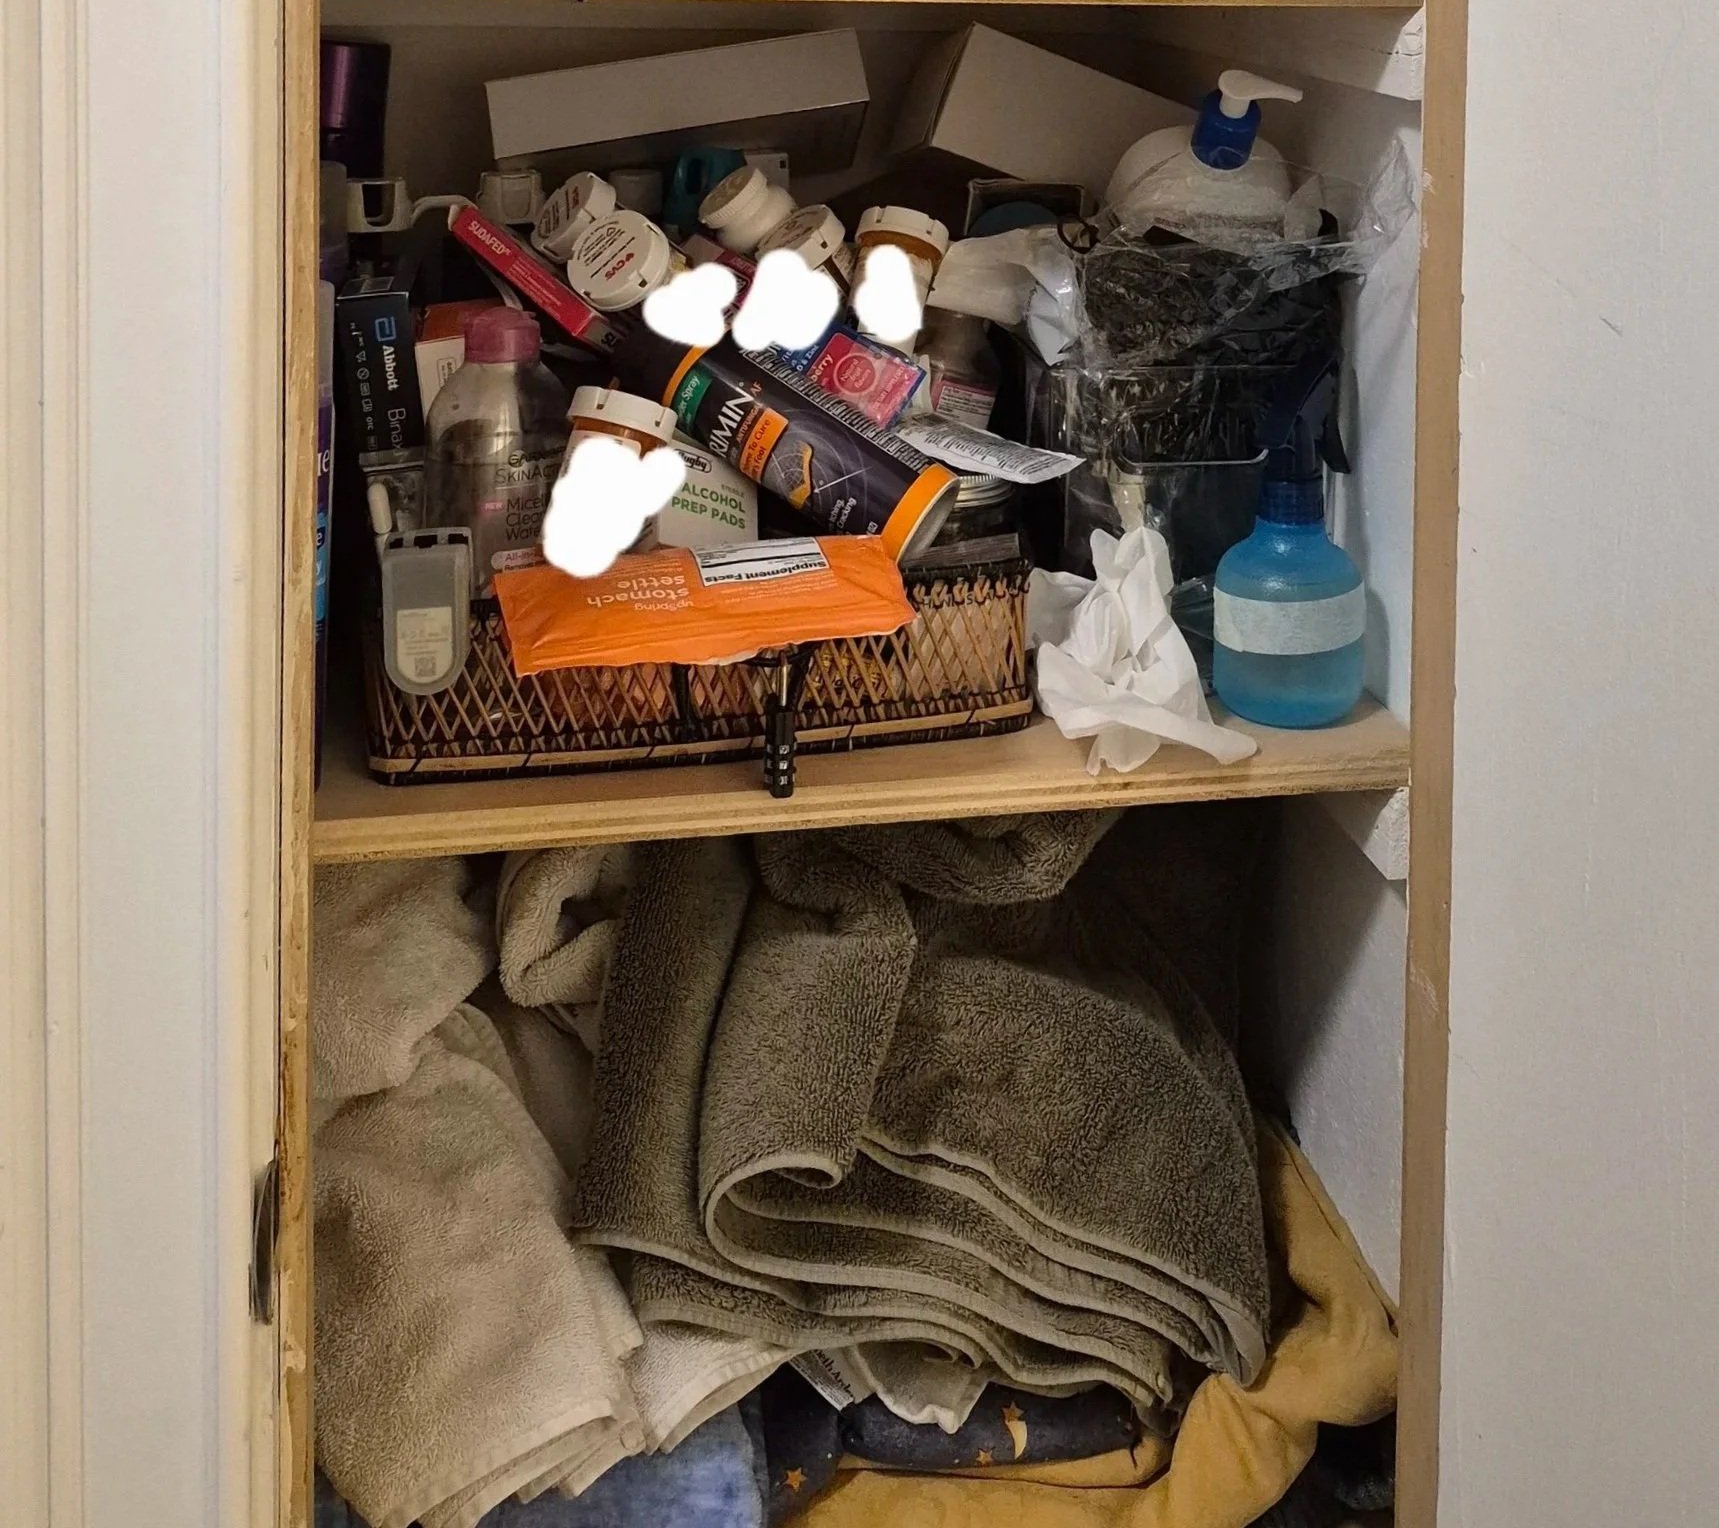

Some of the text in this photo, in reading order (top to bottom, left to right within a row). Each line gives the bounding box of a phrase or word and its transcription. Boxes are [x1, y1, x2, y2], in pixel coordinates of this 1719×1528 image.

[382, 345, 400, 392] Abbott
[682, 375, 701, 401] Spray
[749, 381, 762, 397] AF
[681, 482, 746, 513] ALCOHOL
[671, 496, 746, 530] PREP PADS
[616, 574, 687, 589] settle
[704, 561, 828, 584] Supplement Facts
[586, 587, 690, 608] stomach
[634, 599, 694, 612] upSpring
